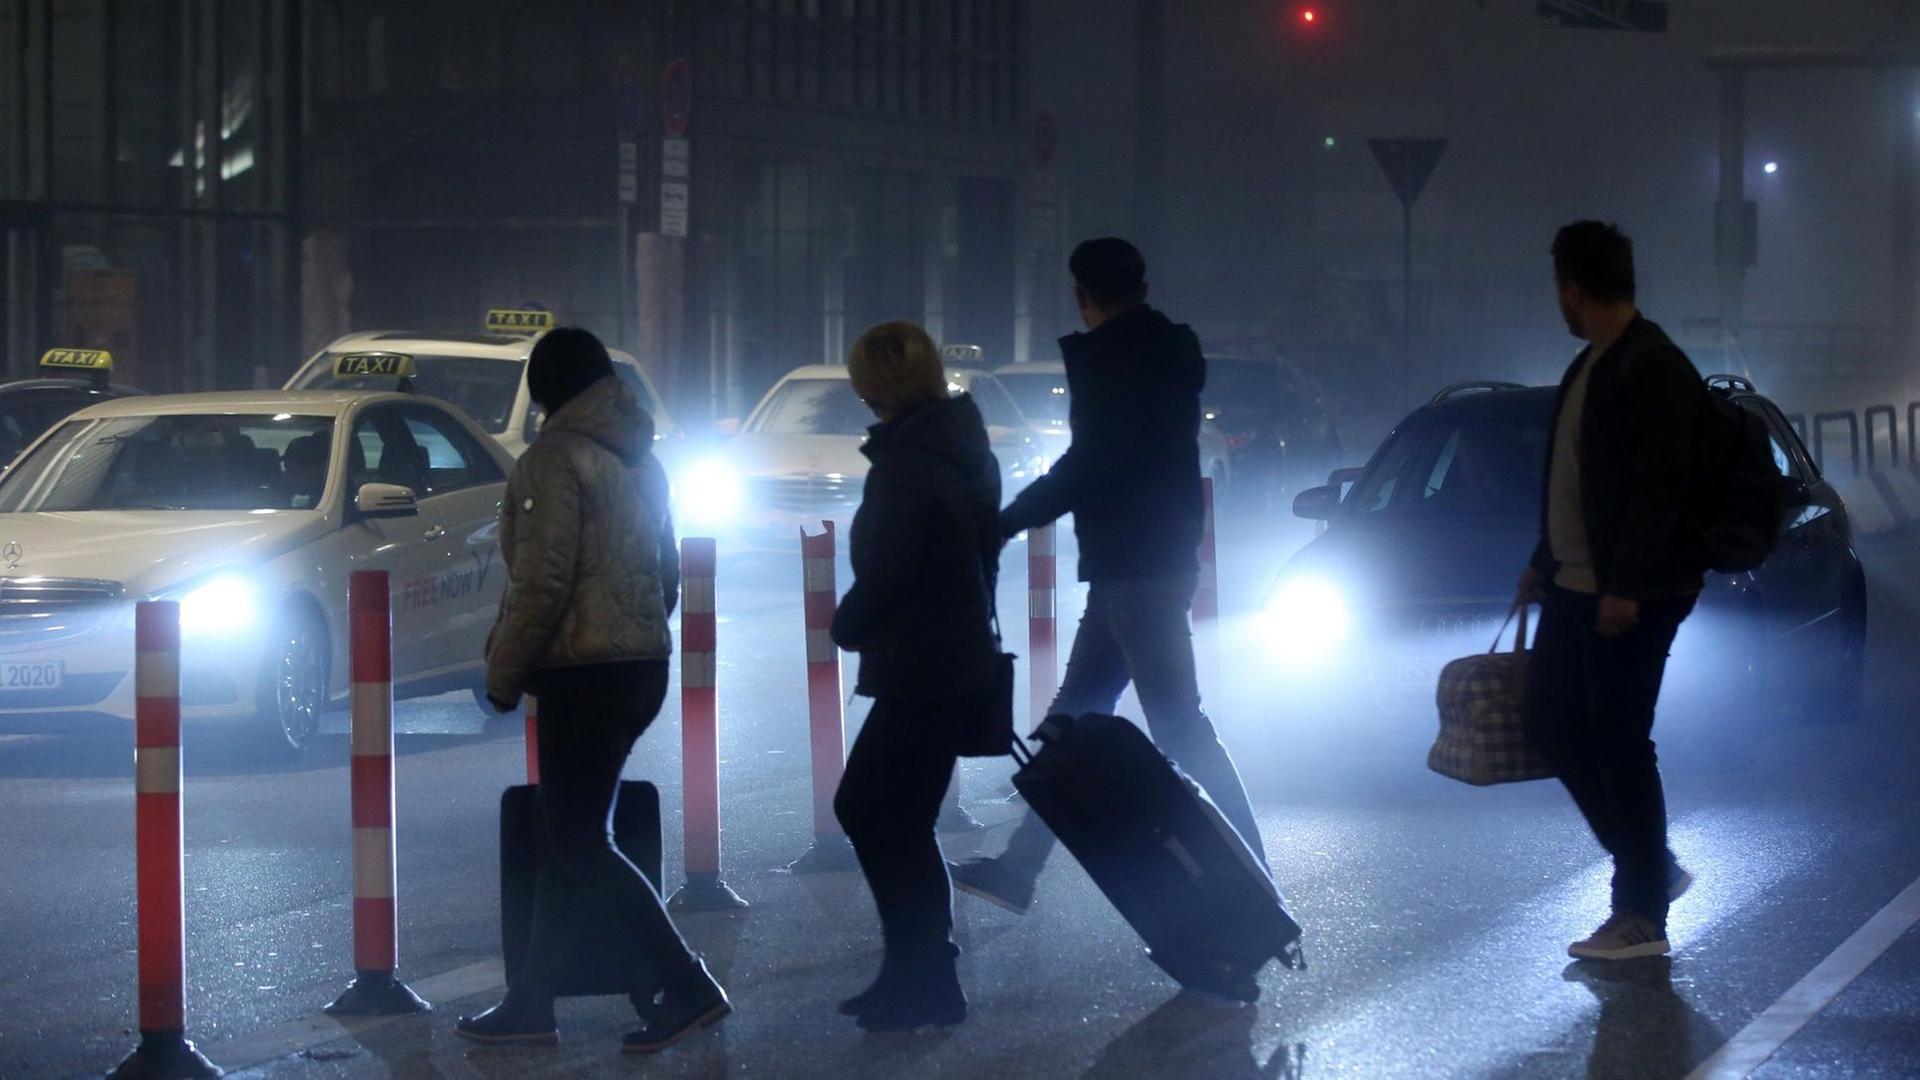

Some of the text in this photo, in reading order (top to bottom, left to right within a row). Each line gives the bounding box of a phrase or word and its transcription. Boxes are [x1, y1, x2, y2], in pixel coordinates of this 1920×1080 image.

[496, 313, 539, 324] TAXI
[52, 351, 97, 364] TAXI
[345, 357, 395, 372] TAXI
[8, 664, 56, 686] 2020
